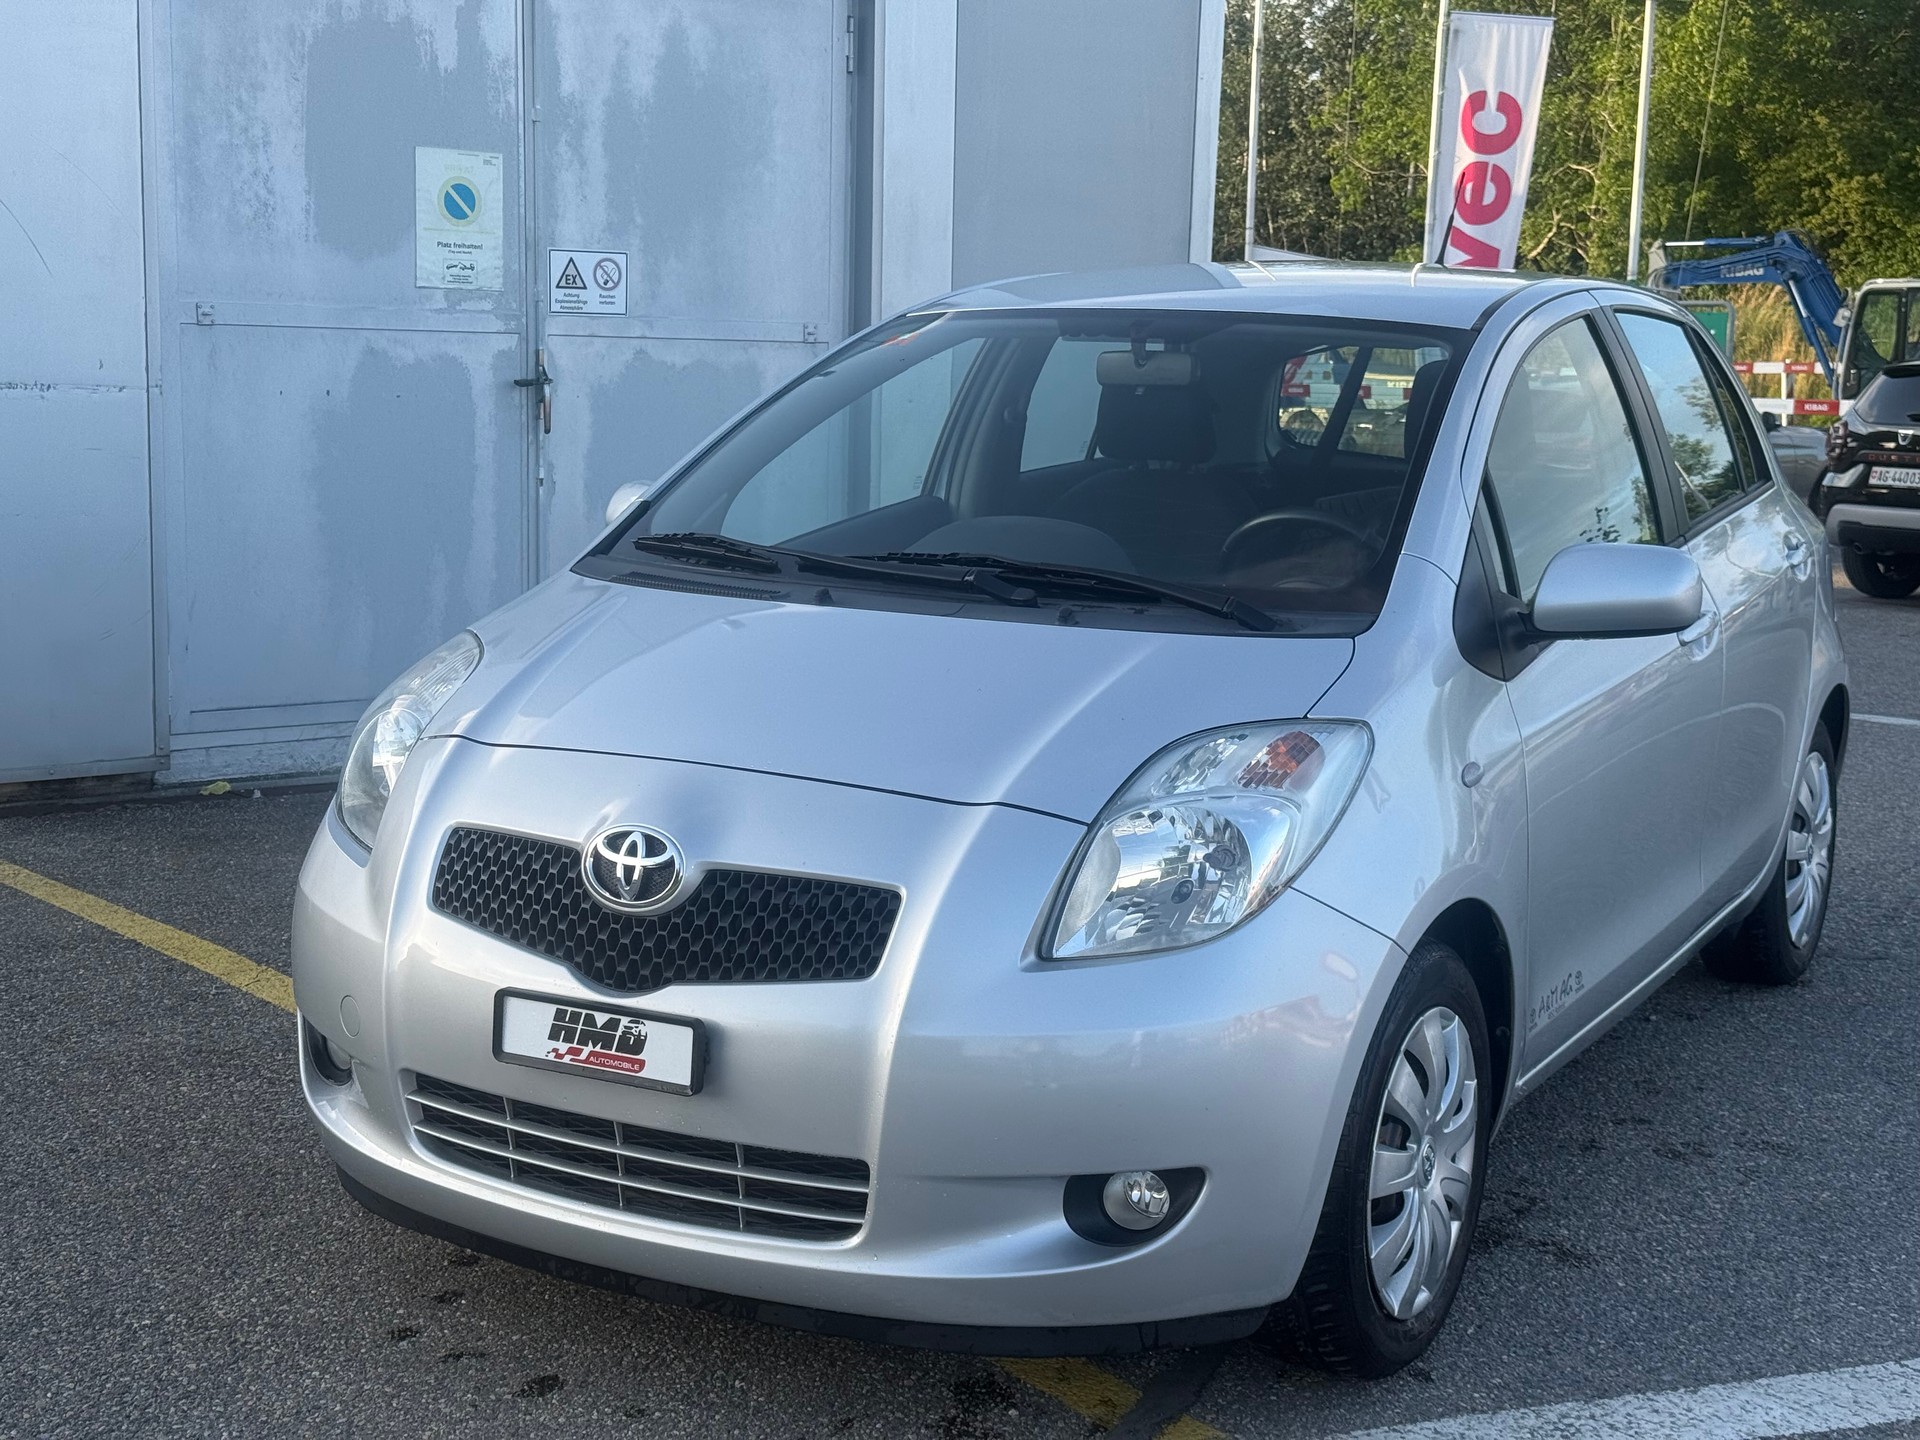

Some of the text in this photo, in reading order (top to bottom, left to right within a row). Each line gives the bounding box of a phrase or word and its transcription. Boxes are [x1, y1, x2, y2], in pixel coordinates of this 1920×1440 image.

[1721, 264, 1764, 278] KIBAG
[565, 274, 577, 286] EX
[1804, 403, 1829, 412] KIBAG
[588, 1055, 641, 1071] AUTOMOBILE
